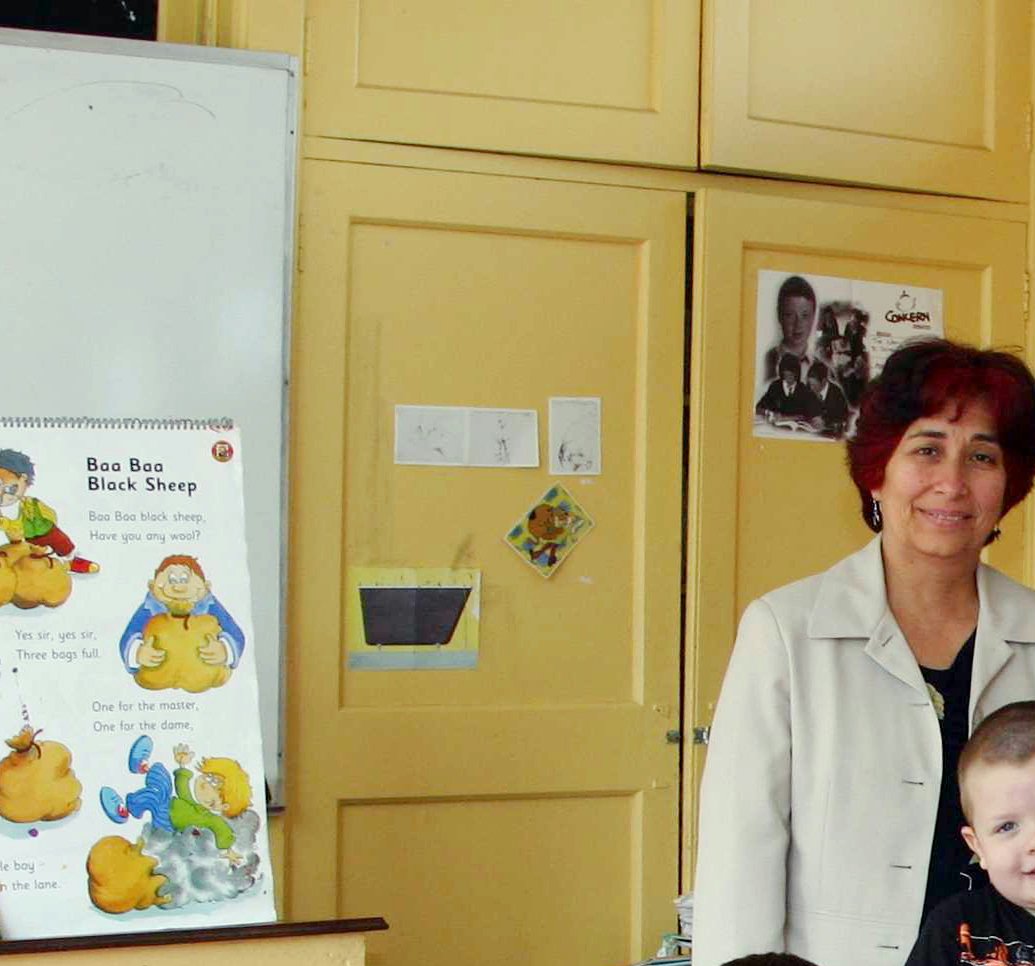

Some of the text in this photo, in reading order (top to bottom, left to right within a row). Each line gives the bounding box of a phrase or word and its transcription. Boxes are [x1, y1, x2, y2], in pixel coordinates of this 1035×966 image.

[885, 310, 931, 324] CONCERN
[87, 457, 164, 473] Baa Baa
[88, 477, 197, 497] Black Sheep
[89, 511, 111, 522] Baa
[115, 511, 137, 522] Baa
[140, 511, 168, 522] black
[90, 530, 201, 544] Have you any wool?
[15, 629, 97, 643] Yes sir, yes sir,
[16, 649, 47, 660] Three
[52, 649, 78, 663] bags
[92, 701, 200, 713] One for the master,
[93, 720, 195, 733] One for the dame,
[13, 860, 35, 874] boy
[12, 880, 31, 891] the
